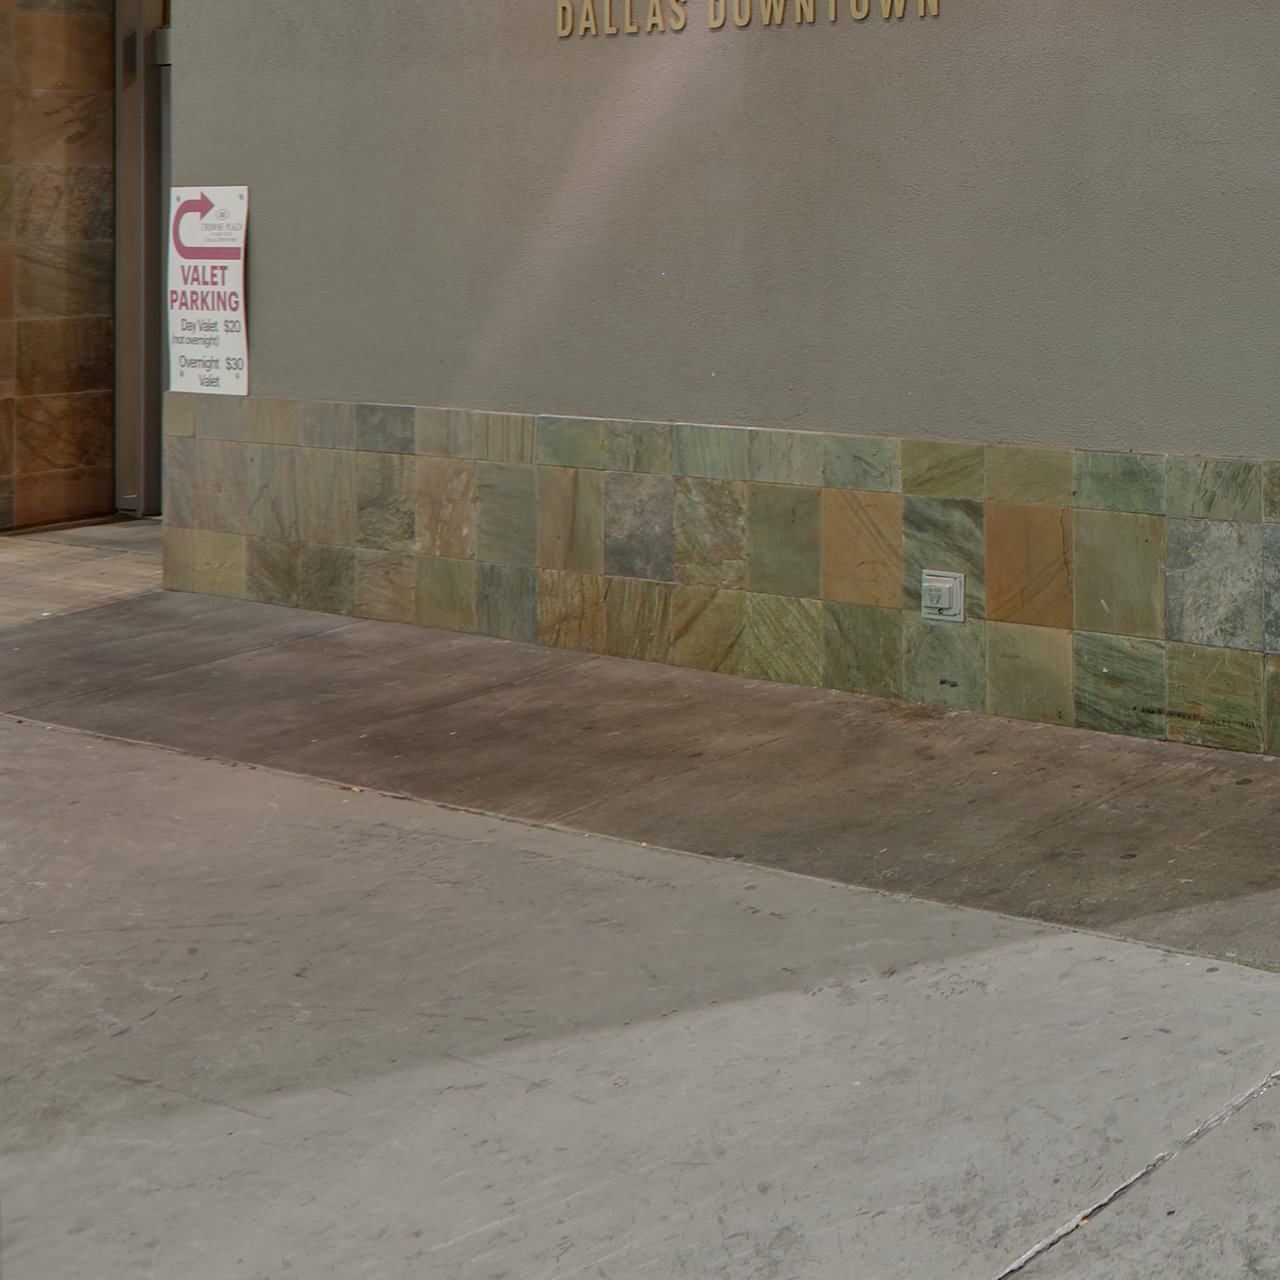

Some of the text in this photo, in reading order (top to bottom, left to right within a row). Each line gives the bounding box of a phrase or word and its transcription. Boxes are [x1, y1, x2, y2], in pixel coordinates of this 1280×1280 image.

[180, 265, 228, 286] VALET
[169, 290, 239, 312] PARKING
[181, 319, 241, 335] Day Valet $20
[179, 355, 244, 373] Overnight $30
[198, 374, 220, 388] Valet
